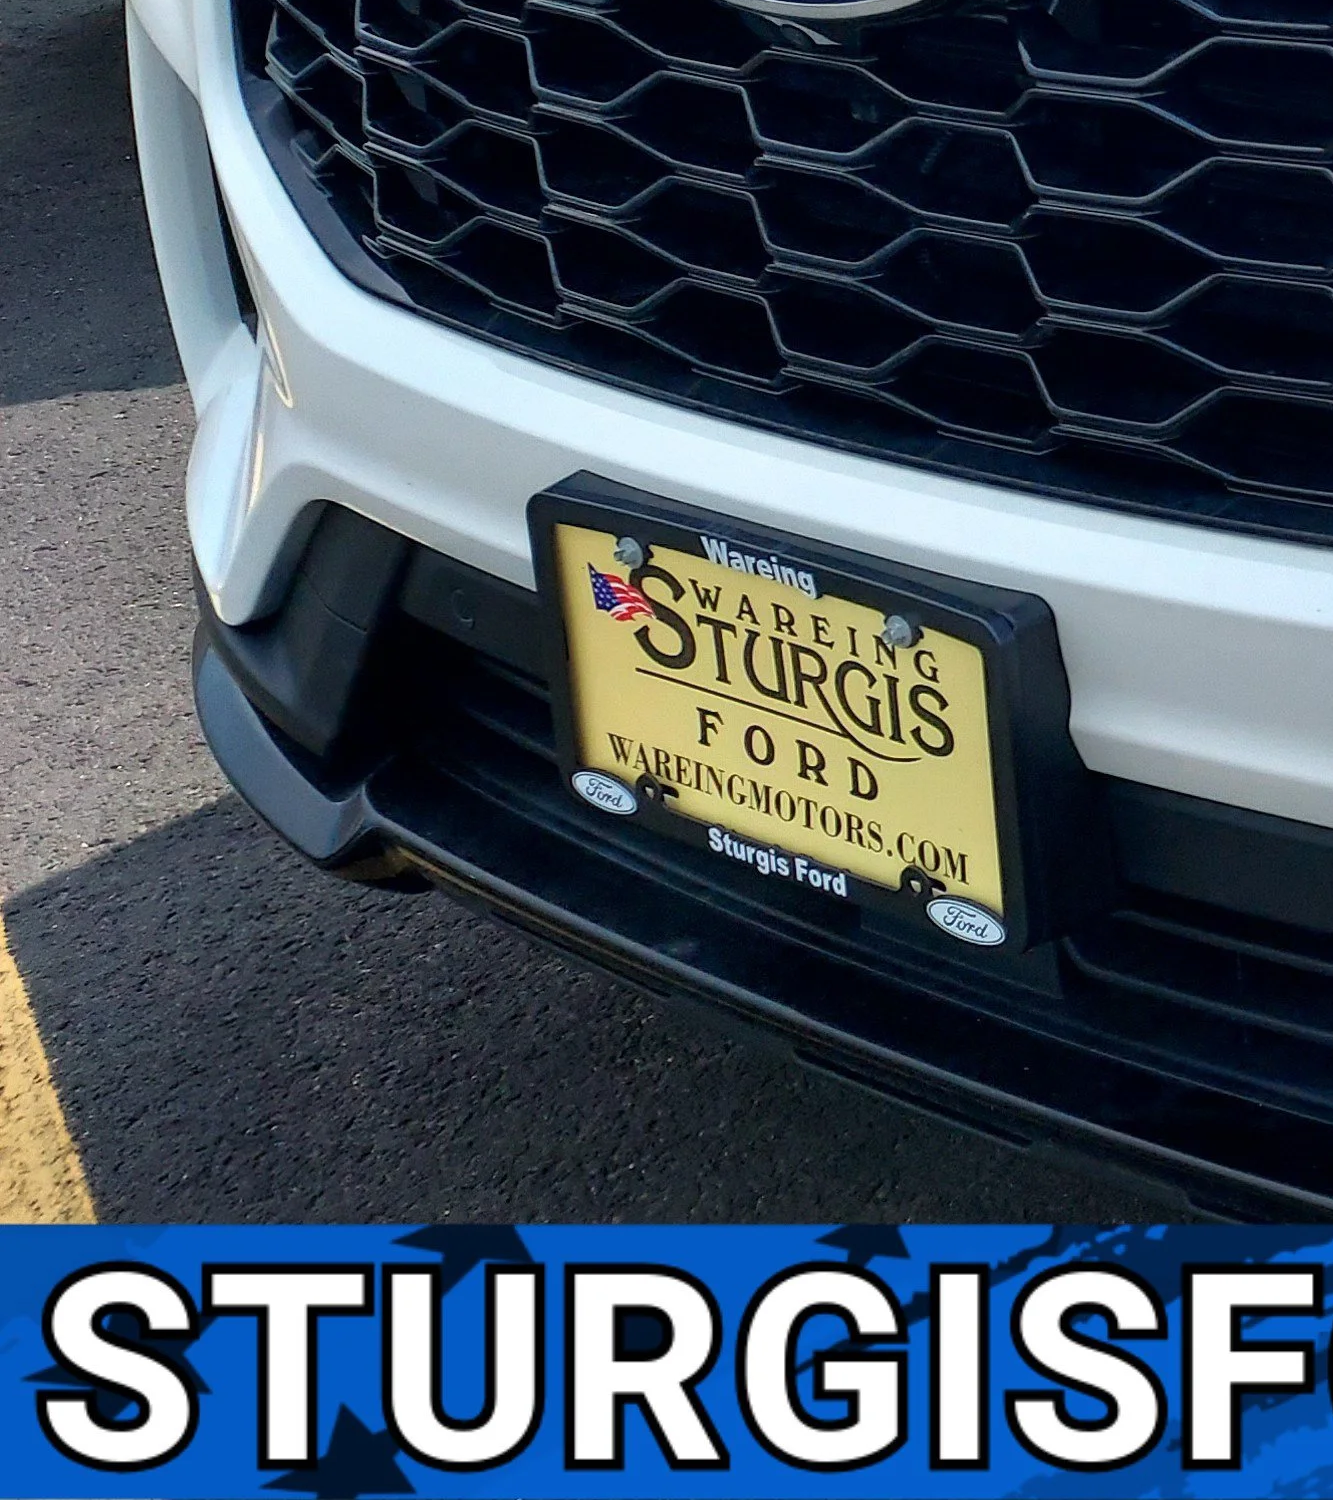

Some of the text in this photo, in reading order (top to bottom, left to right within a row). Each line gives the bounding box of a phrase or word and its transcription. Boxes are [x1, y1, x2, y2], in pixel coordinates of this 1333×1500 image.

[701, 535, 818, 599] Wareing
[628, 565, 955, 763] STURGIS
[688, 578, 941, 684] WAREING
[585, 778, 624, 810] Ford
[696, 707, 880, 801] FORD
[606, 732, 970, 886] WAREINGMOTORS.COM
[708, 827, 848, 898] Sturgis Ford
[945, 905, 989, 940] Ford
